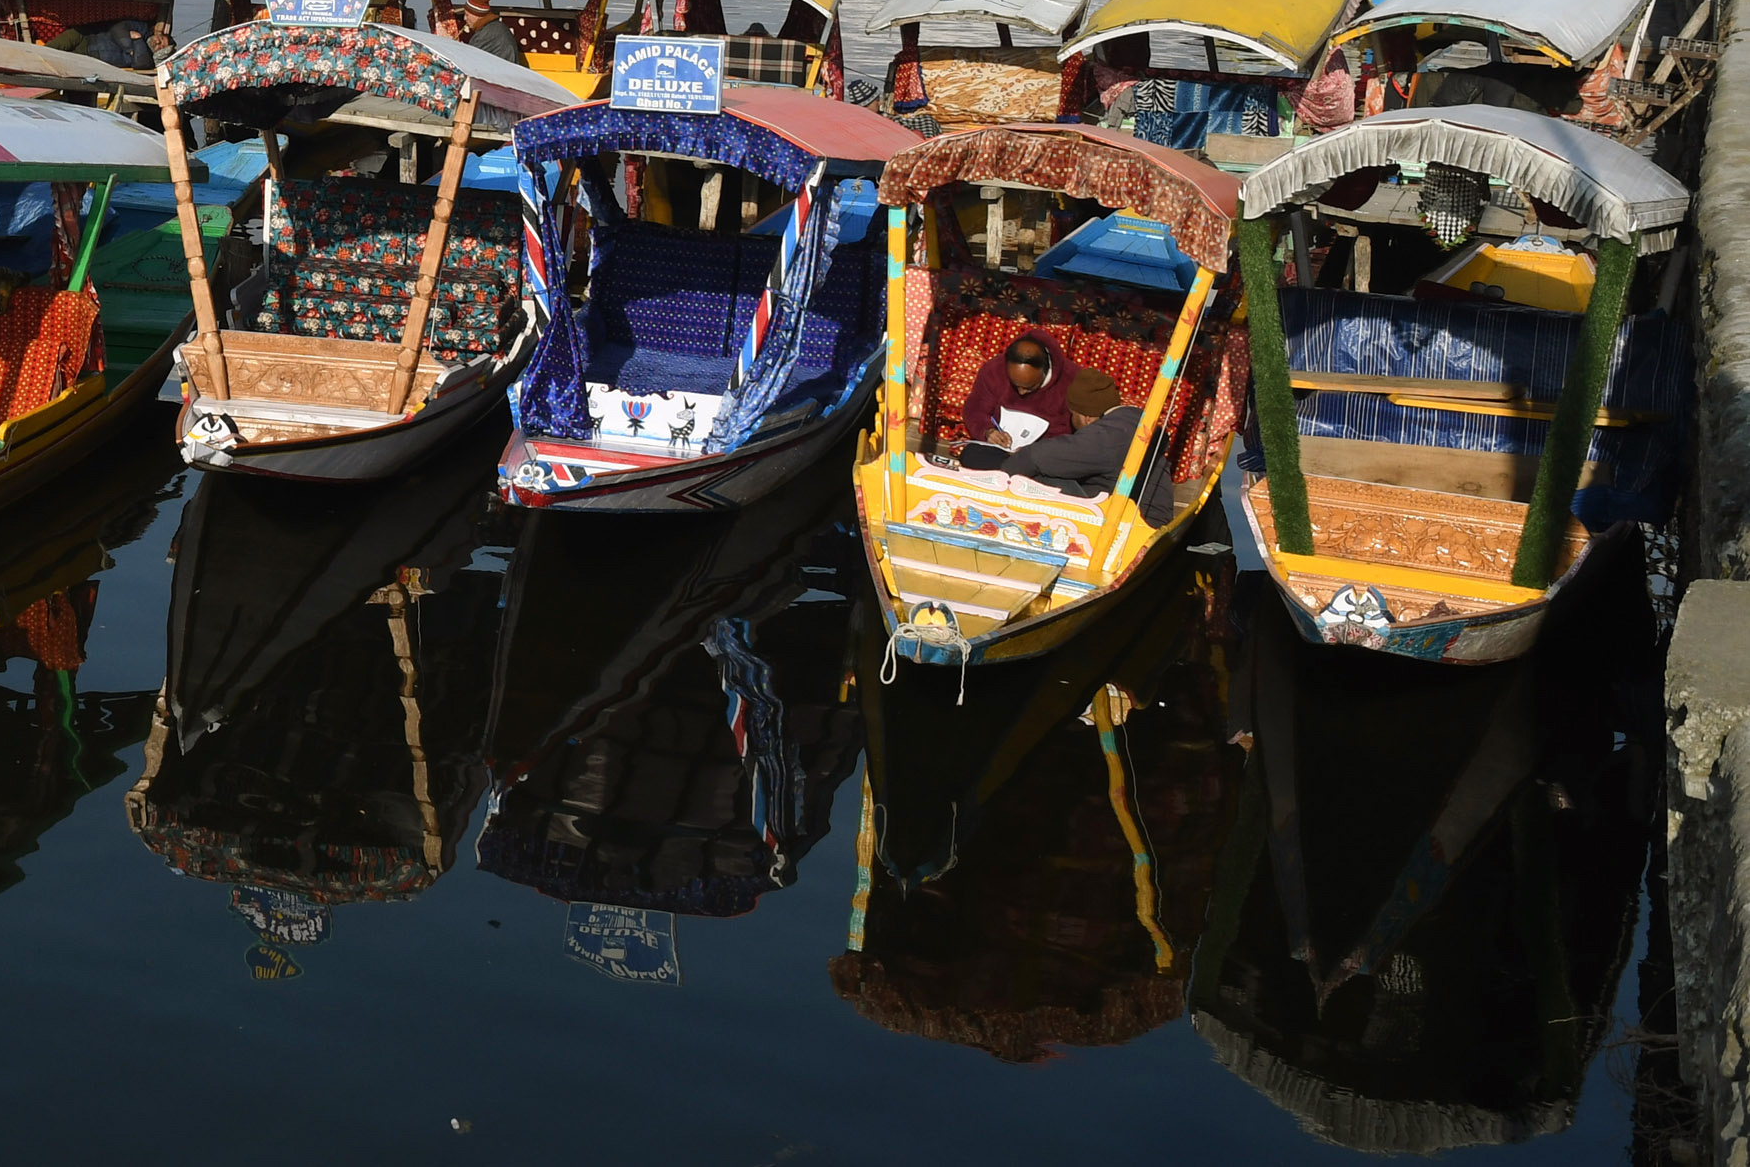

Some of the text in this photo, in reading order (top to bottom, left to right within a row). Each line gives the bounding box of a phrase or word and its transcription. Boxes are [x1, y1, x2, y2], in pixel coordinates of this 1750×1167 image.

[616, 45, 716, 80] HAMID PALACE
[628, 78, 704, 94] DELUXE
[636, 97, 693, 110] Ghat No. 7
